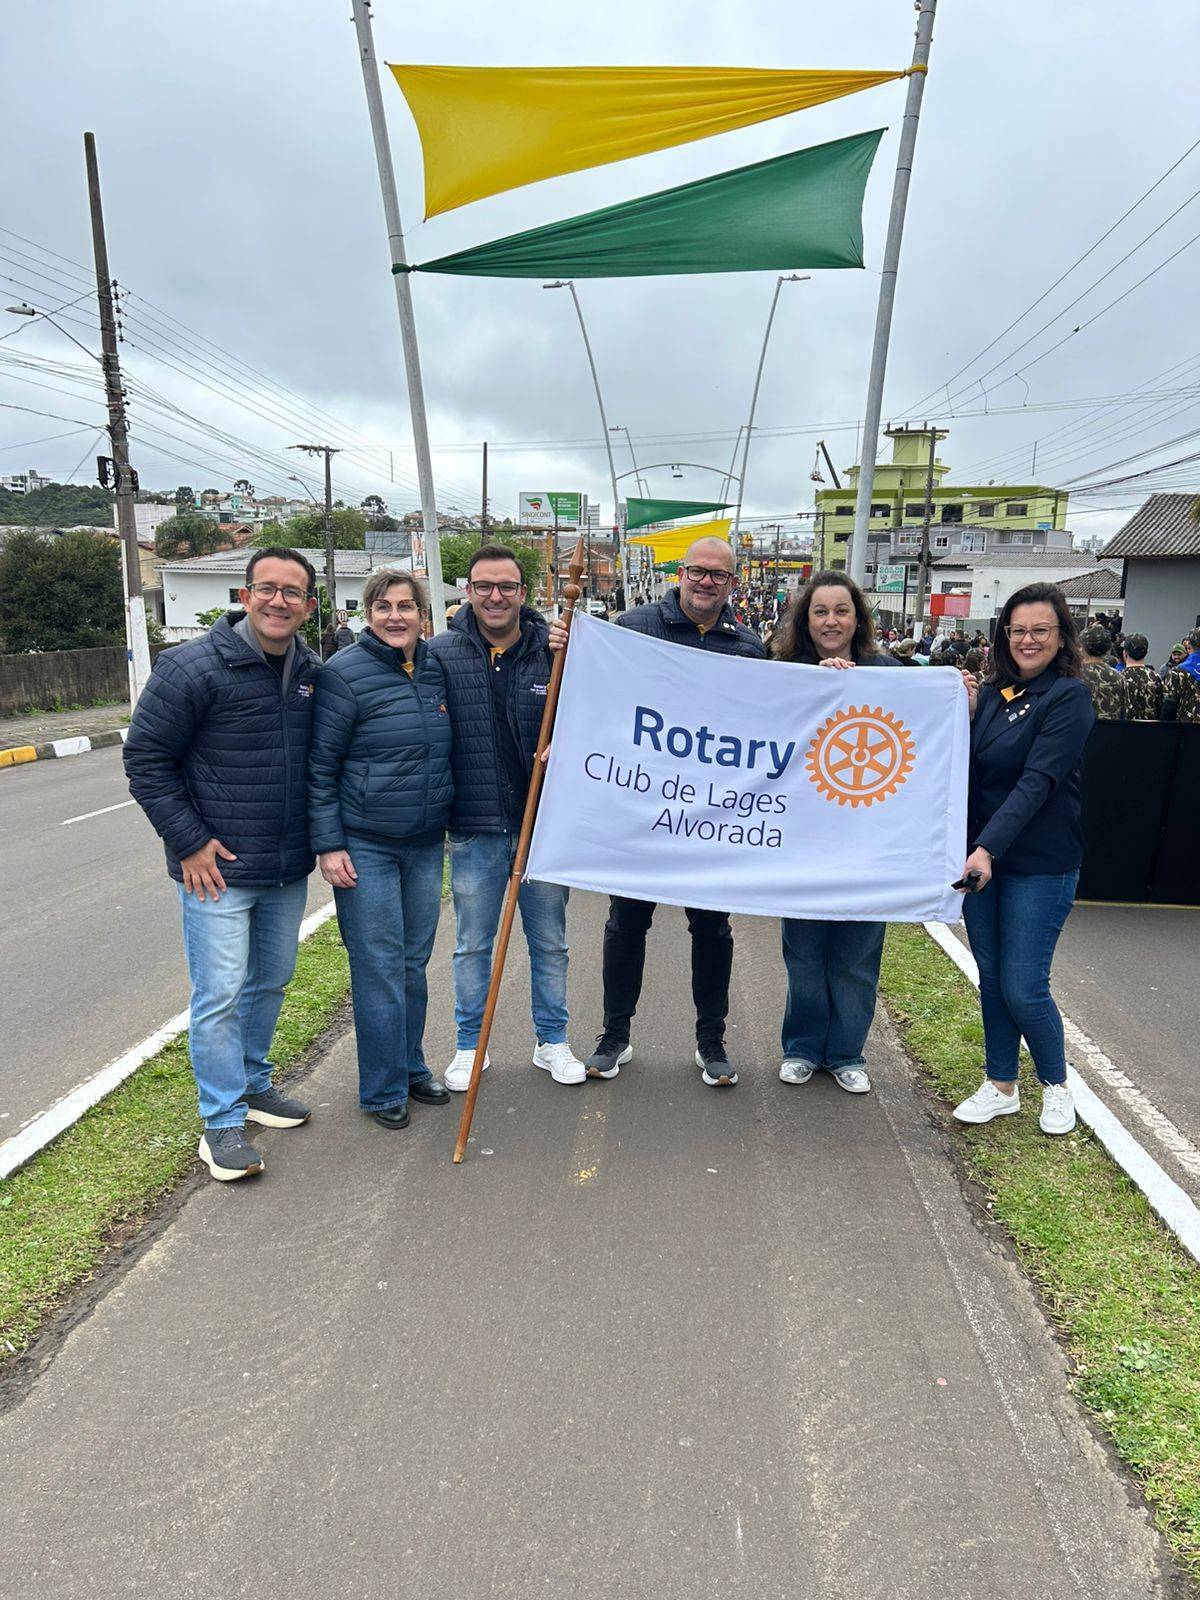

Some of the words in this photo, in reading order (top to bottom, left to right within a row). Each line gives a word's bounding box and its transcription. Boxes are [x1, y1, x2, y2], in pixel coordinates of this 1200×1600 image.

[633, 705, 796, 780] Rotary
[584, 752, 651, 793] Club
[661, 774, 696, 803] de
[707, 782, 788, 818] Lages
[651, 807, 782, 848] Alvorada
